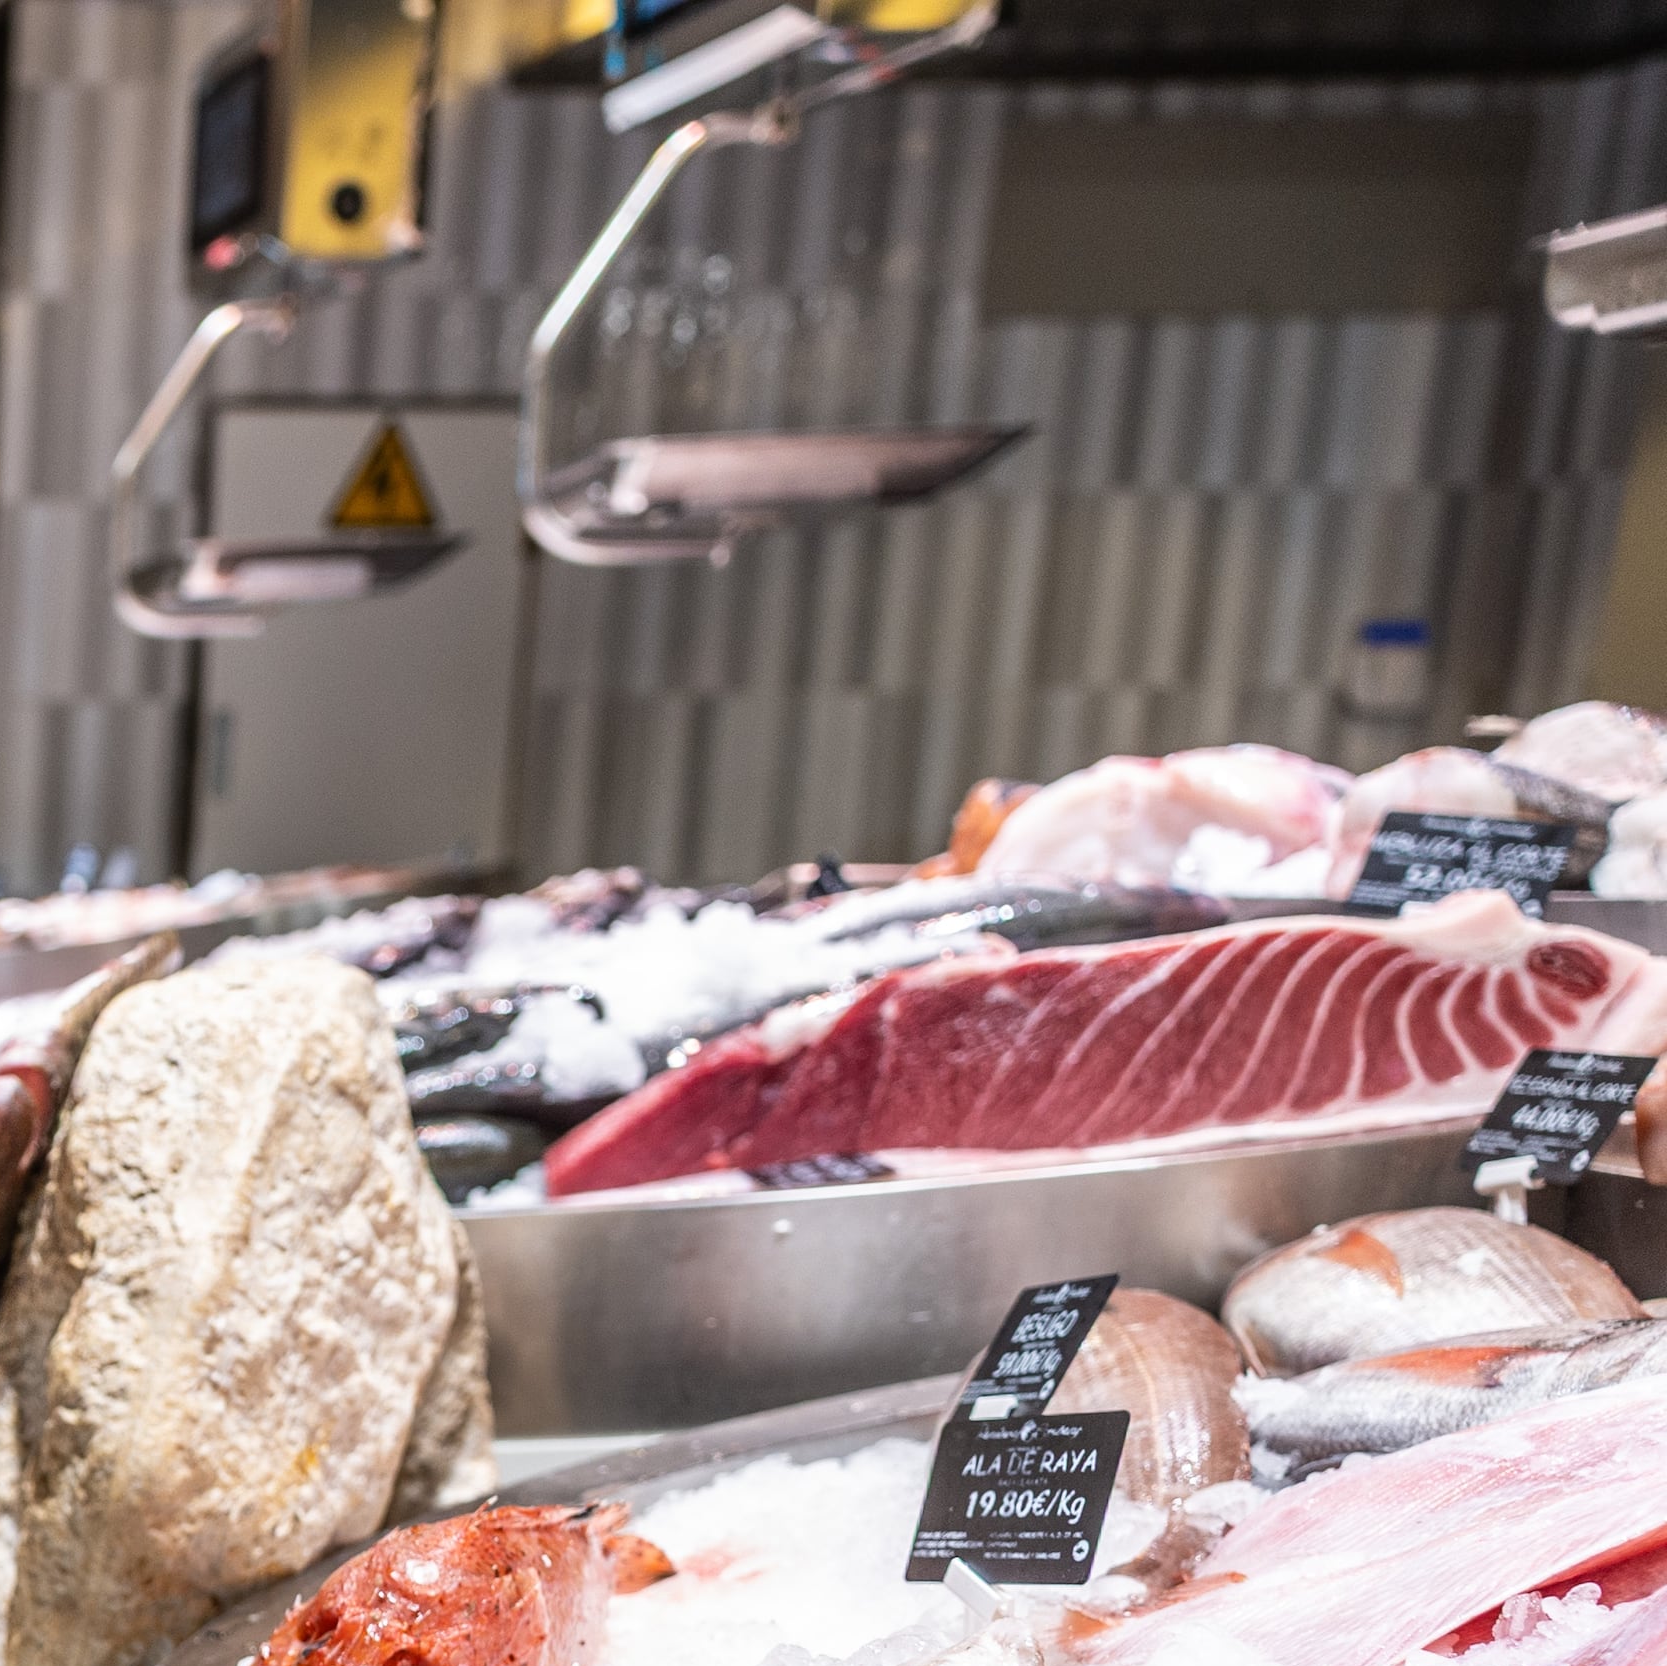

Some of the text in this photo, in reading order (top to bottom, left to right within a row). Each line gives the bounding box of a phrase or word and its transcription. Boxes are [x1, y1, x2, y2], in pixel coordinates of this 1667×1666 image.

[1011, 1309, 1079, 1343] BESUGO
[961, 1449, 1098, 1476] ALA DE RAYA
[966, 1489, 1086, 1525] 19.80€/Kg
